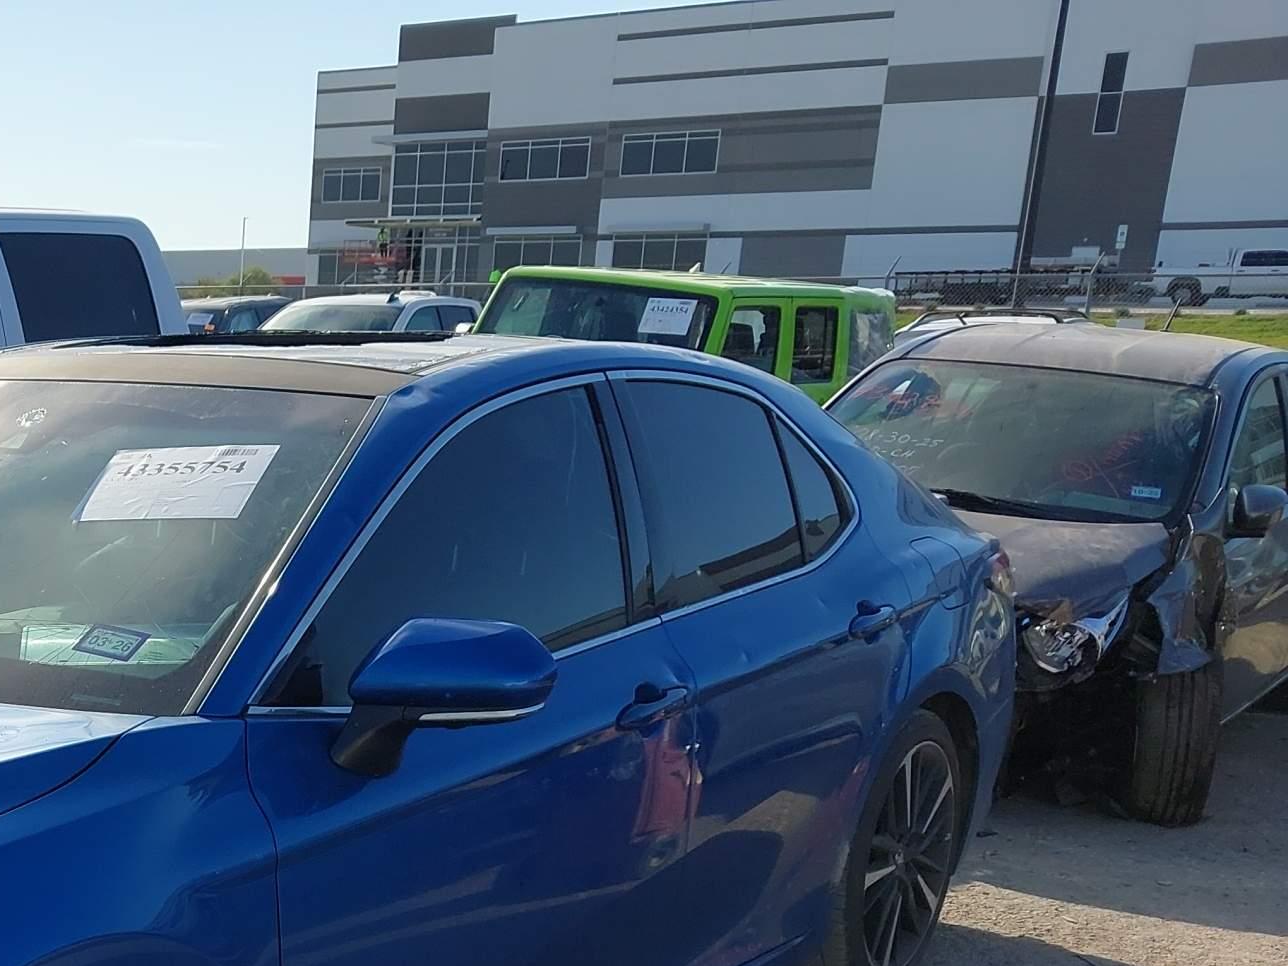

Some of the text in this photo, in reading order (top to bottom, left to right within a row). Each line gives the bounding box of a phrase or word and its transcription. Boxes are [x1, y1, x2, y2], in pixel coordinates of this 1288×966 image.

[117, 460, 248, 478] 43355754
[87, 634, 134, 652] 03 26
